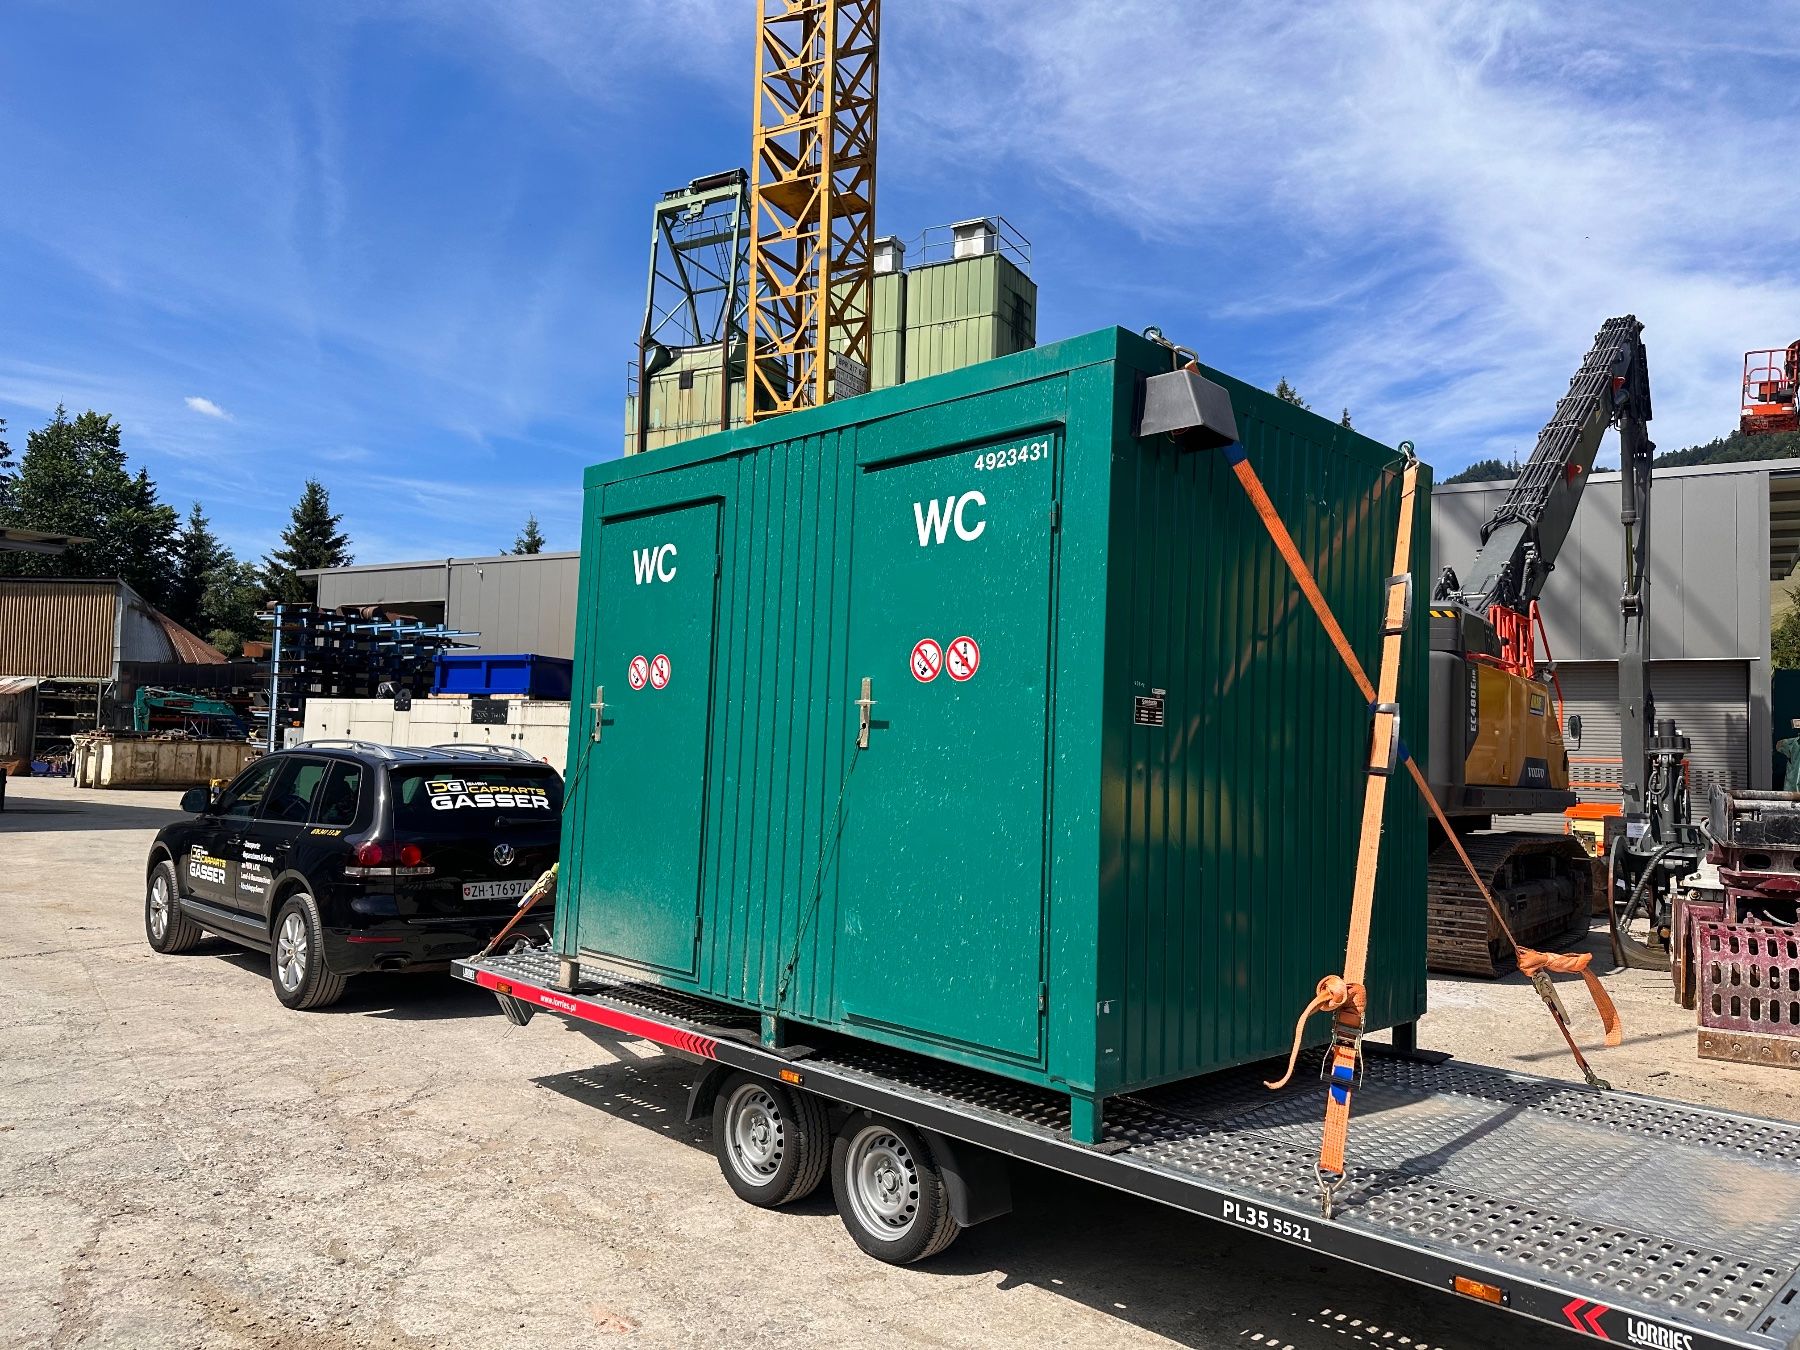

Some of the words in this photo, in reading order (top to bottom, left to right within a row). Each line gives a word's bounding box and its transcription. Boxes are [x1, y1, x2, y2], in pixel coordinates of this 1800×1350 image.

[974, 440, 1048, 471] 4923431
[913, 490, 987, 547] WC
[632, 543, 677, 586] WC
[431, 794, 550, 810] GASSER
[468, 786, 546, 796] CAPPARTS
[189, 862, 226, 885] GASSER
[1223, 1200, 1269, 1229] PL35
[1273, 1217, 1312, 1243] 5521
[1627, 1317, 1693, 1350] LORRIES
